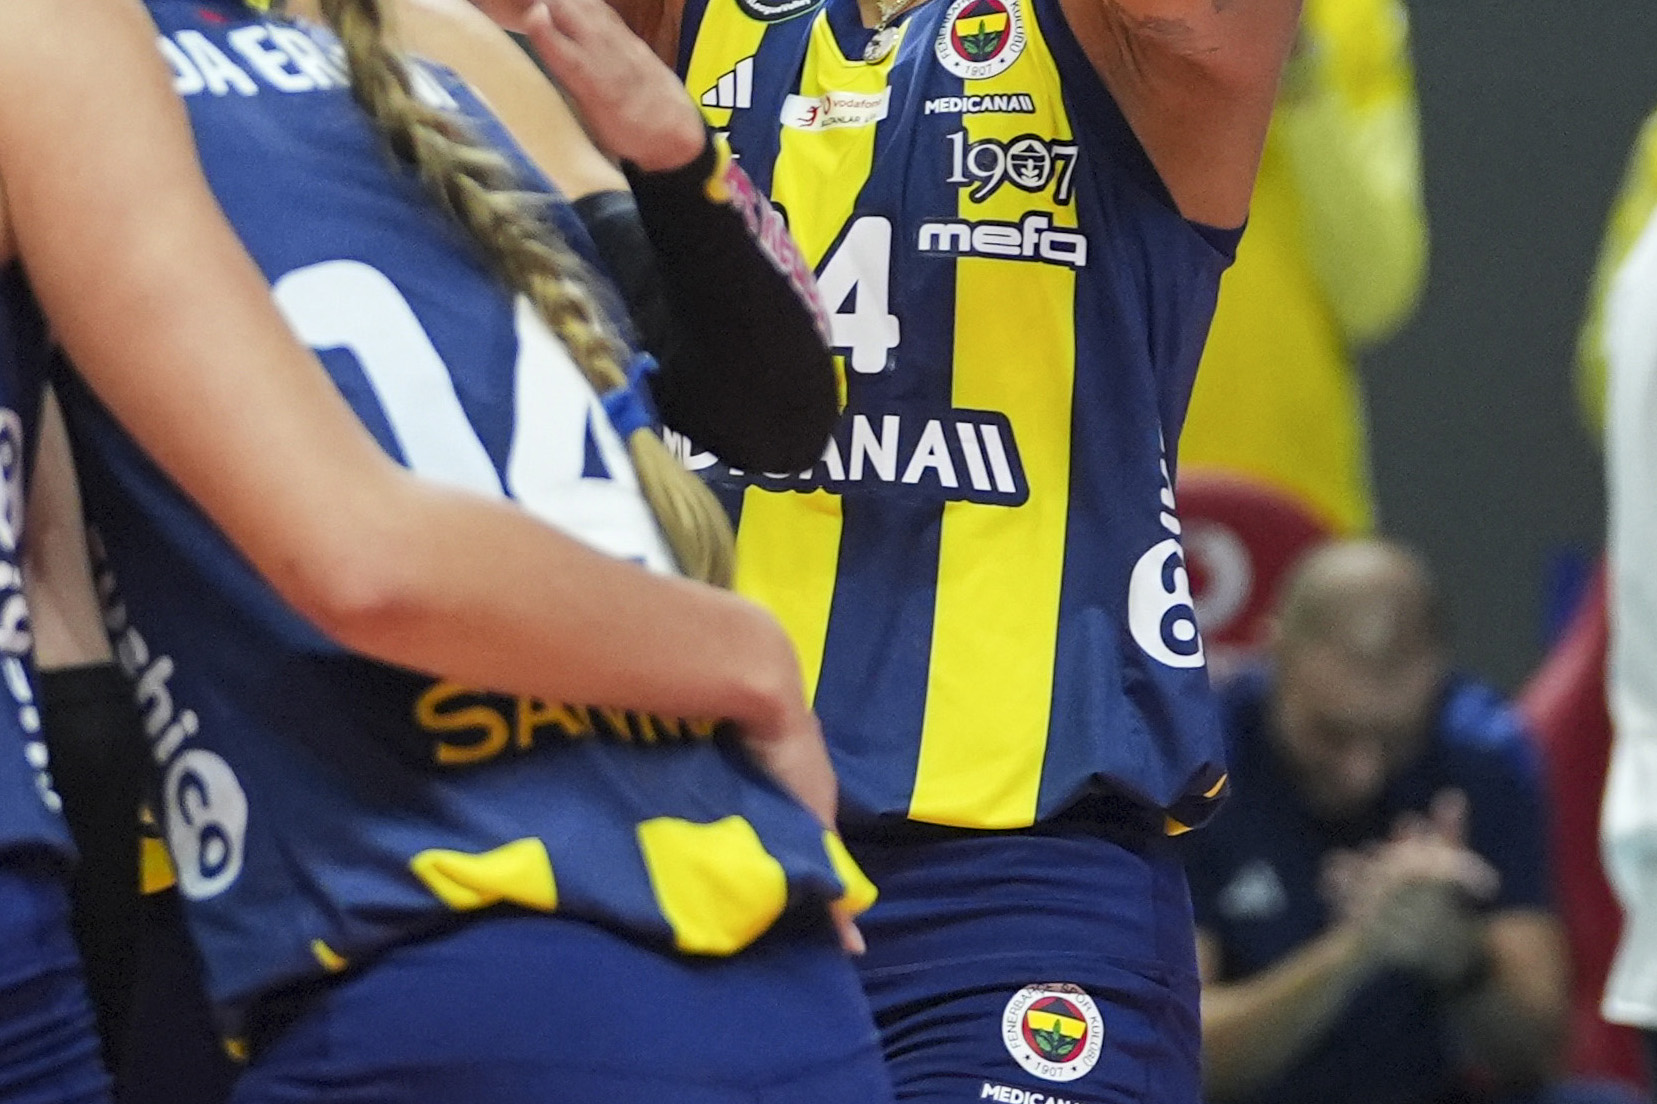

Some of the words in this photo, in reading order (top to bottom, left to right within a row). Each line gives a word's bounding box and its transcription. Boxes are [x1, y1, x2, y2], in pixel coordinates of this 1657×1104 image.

[965, 64, 992, 76] 1907
[945, 131, 1079, 200] 1907
[918, 215, 1088, 267] mefa
[1033, 1061, 1064, 1077] 1907
